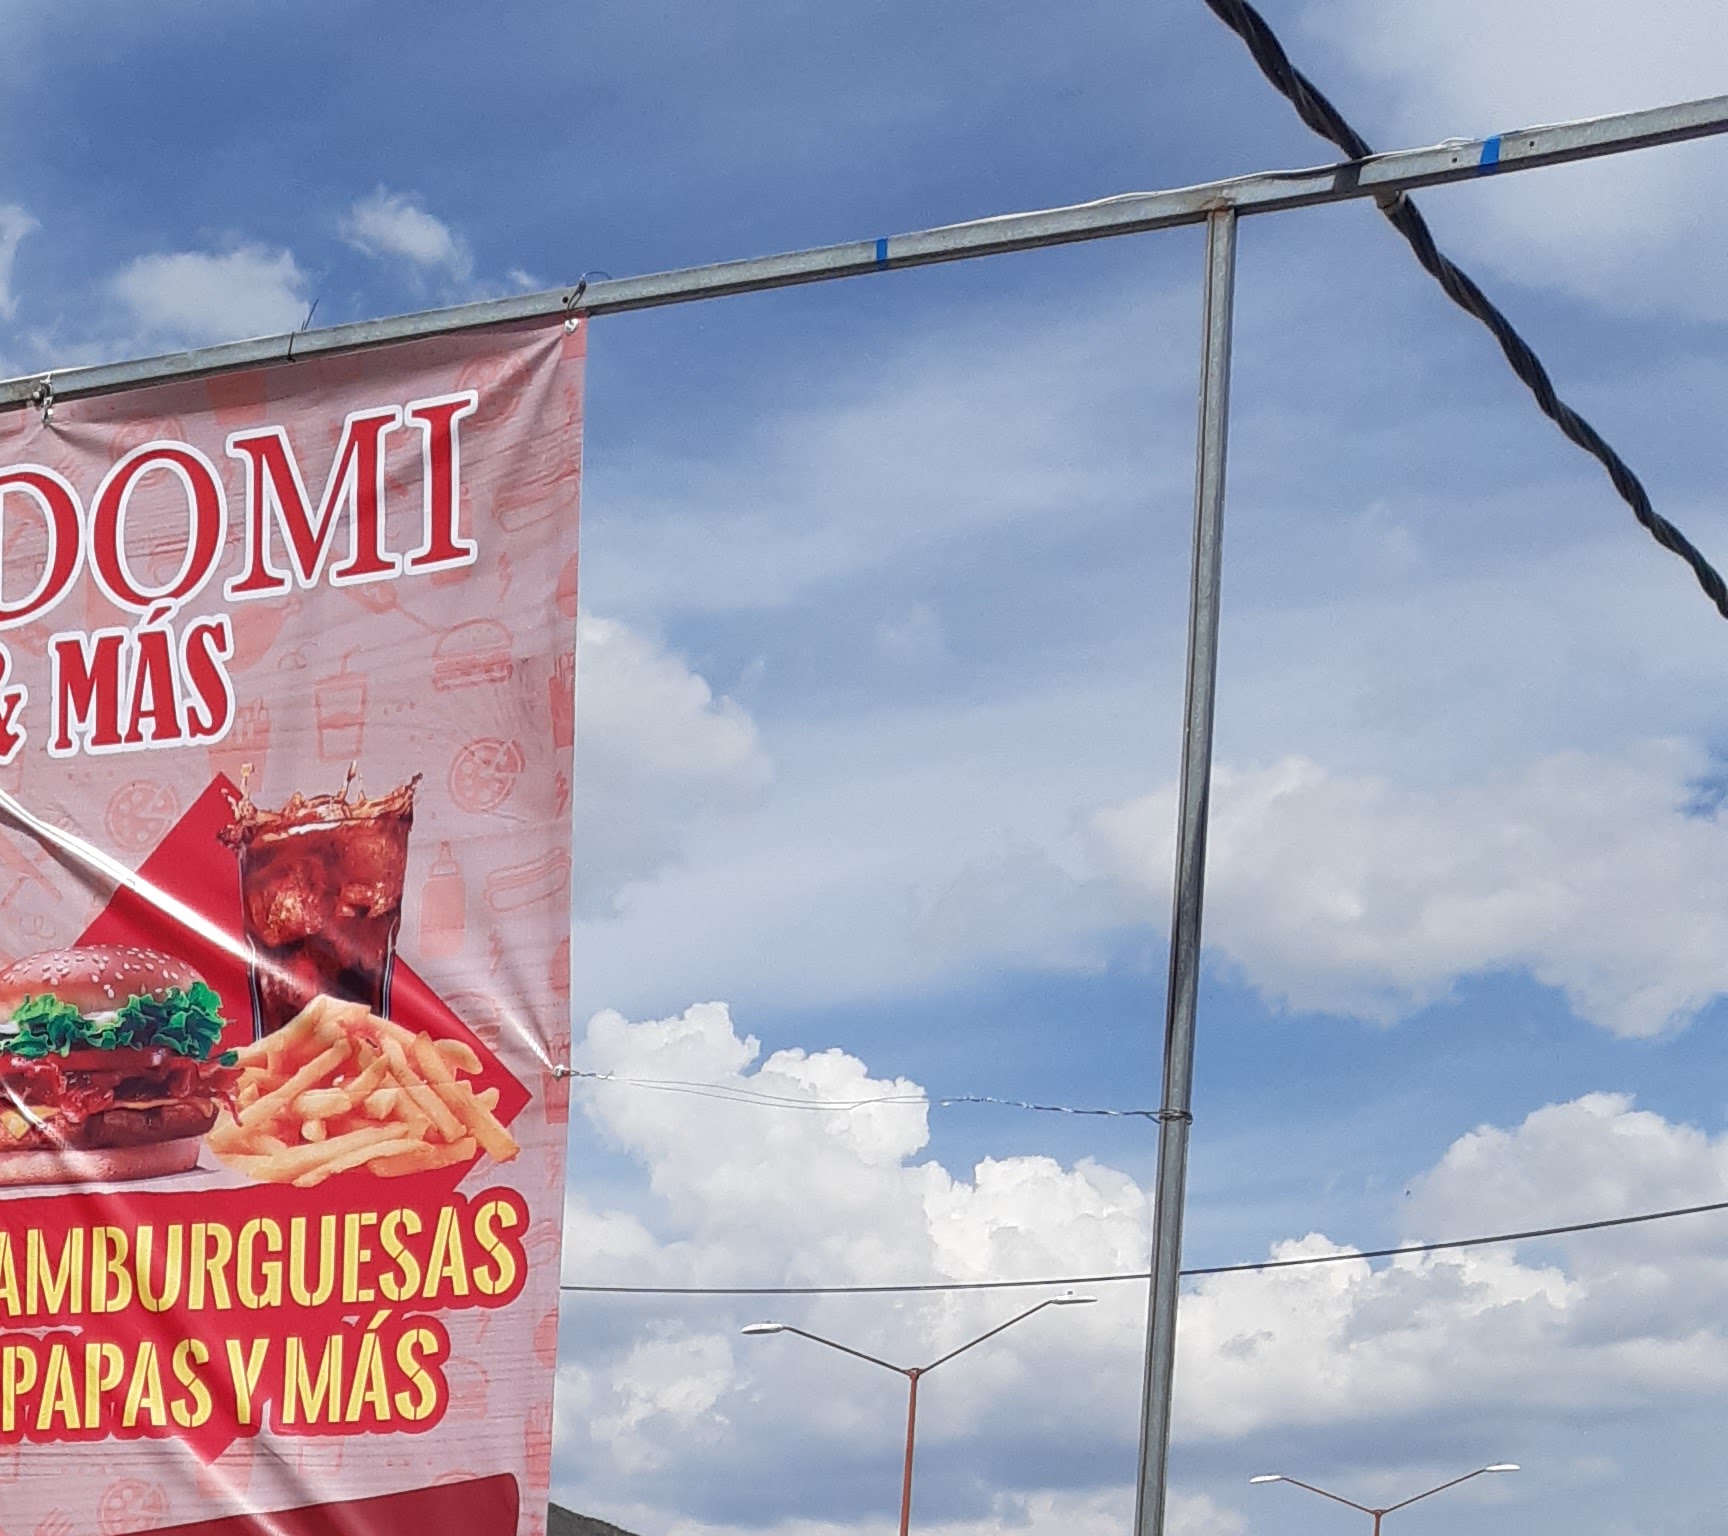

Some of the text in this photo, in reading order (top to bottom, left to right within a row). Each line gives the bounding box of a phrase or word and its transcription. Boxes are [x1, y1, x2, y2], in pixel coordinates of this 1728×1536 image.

[48, 600, 234, 759] MÁS
[1, 1309, 440, 1432] PAPAS Y MÁS
